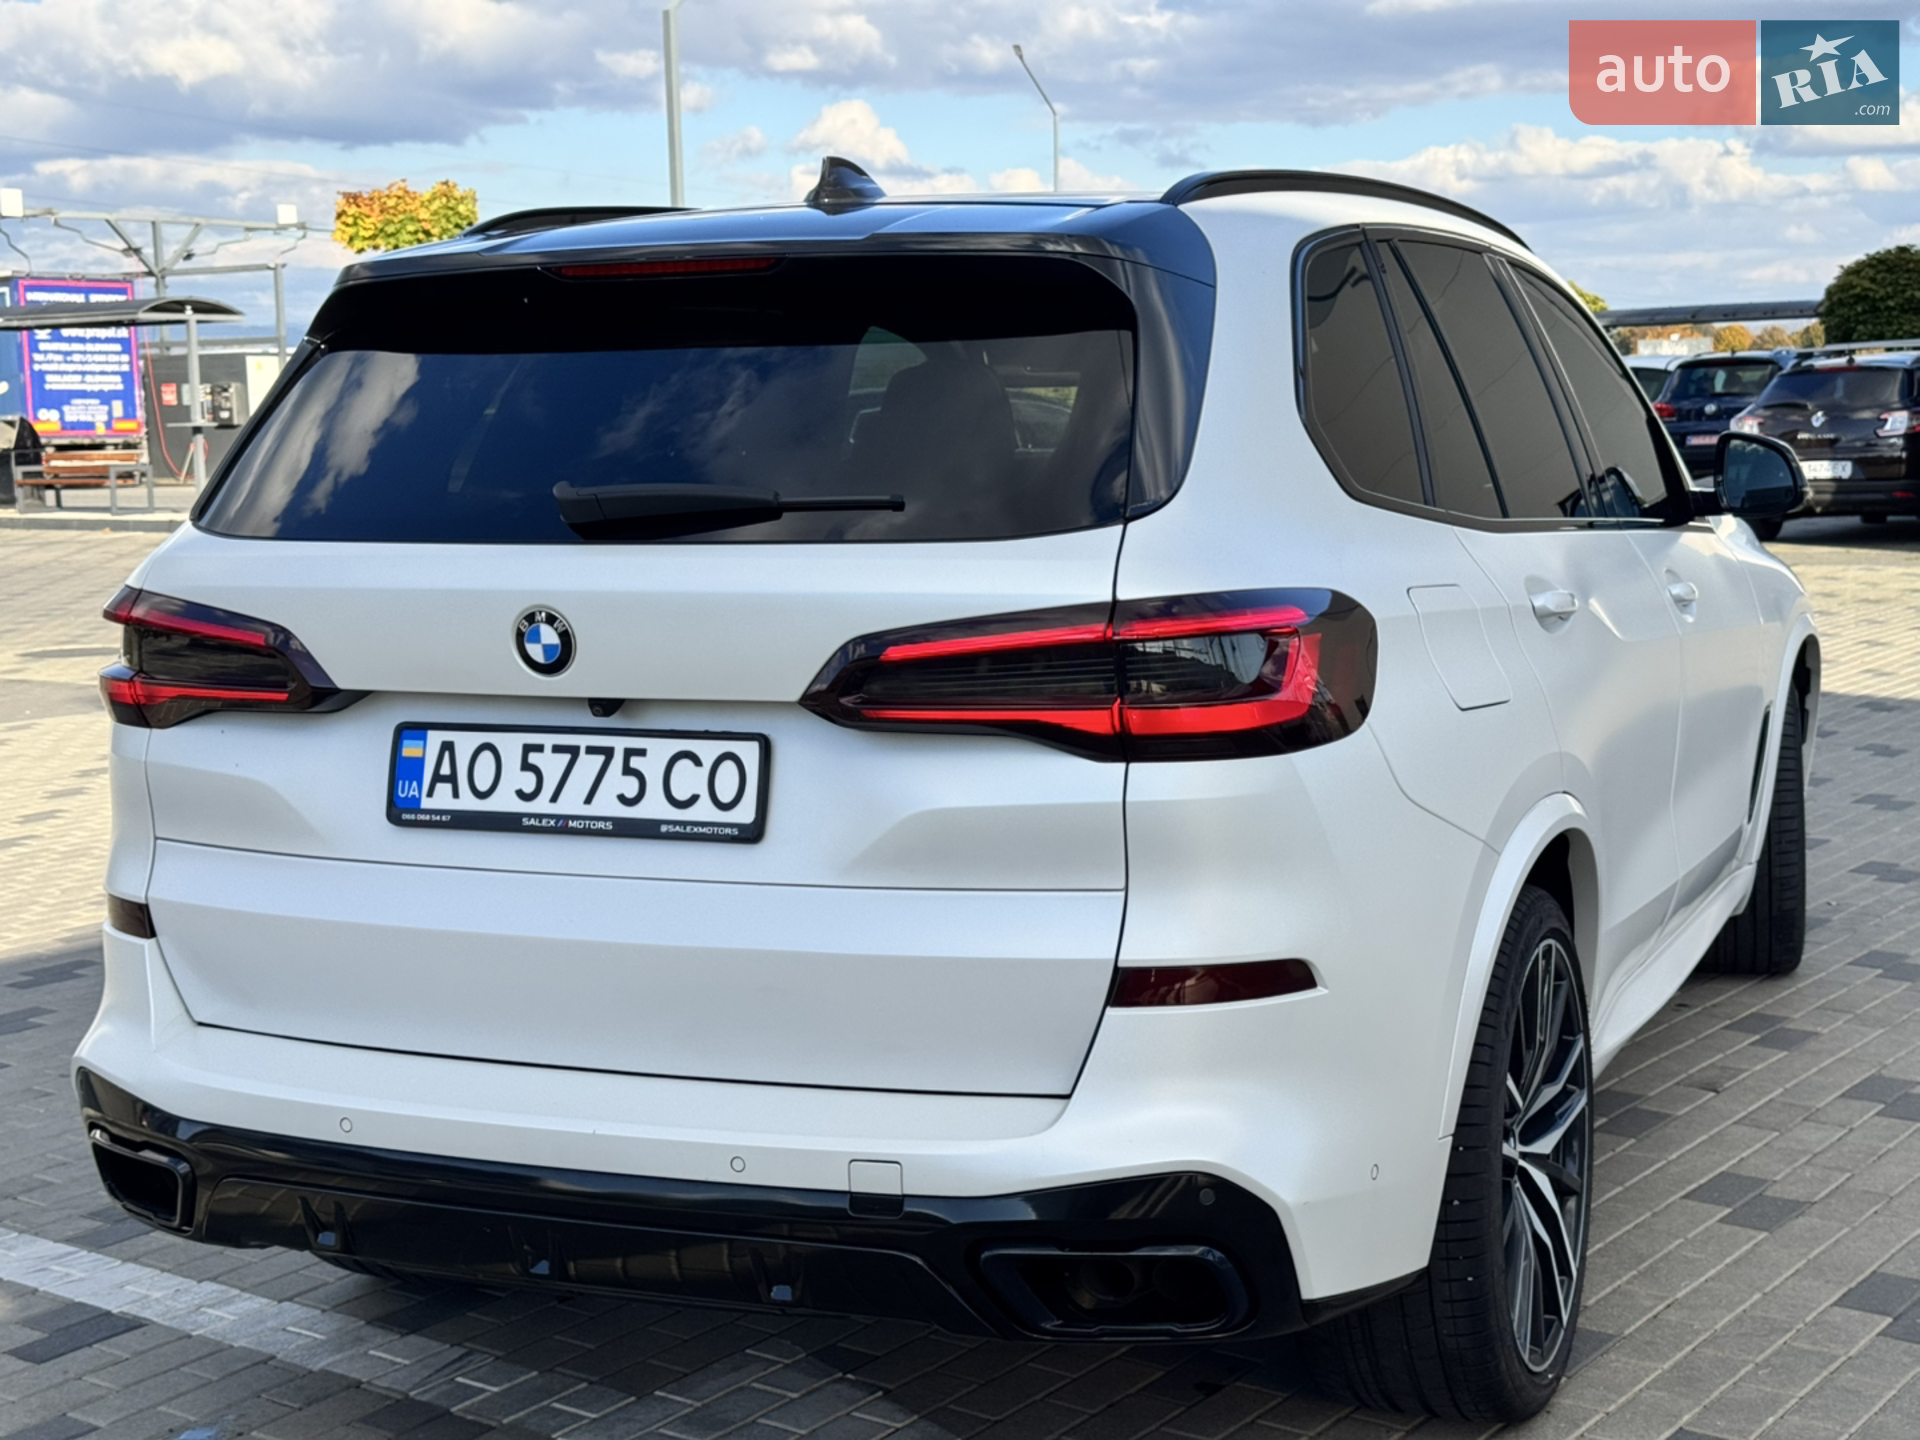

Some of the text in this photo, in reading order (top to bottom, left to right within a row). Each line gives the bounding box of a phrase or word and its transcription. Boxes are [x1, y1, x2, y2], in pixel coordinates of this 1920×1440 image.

[518, 611, 567, 633] BMW
[426, 740, 747, 812] AO 5775 CO
[398, 780, 420, 799] UA
[522, 817, 613, 830] SALEX MOTORS
[660, 824, 739, 836] @SALEXMOTORS
